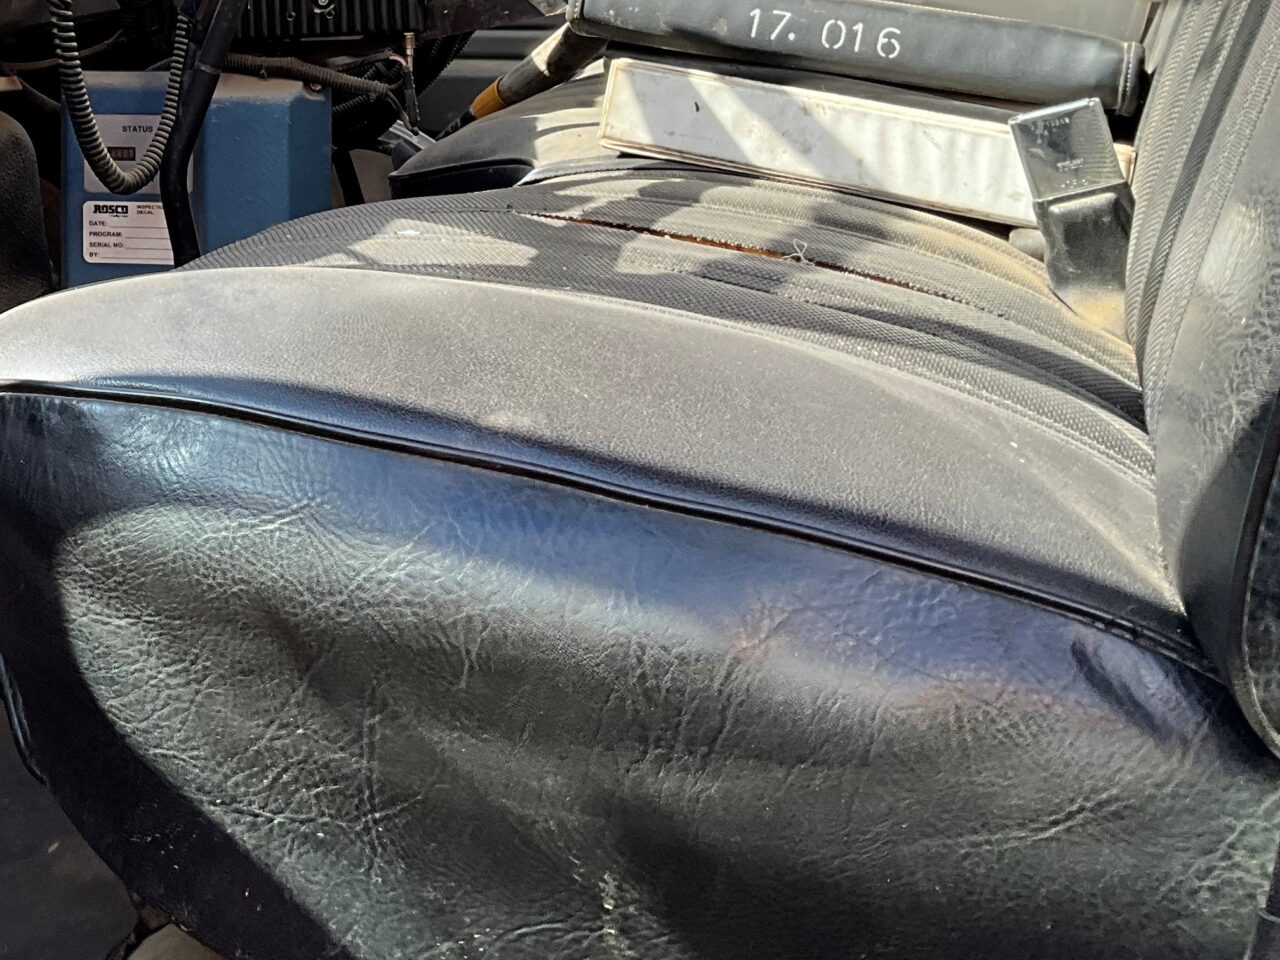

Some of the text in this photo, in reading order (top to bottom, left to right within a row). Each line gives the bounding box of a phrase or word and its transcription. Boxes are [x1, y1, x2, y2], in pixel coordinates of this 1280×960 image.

[749, 8, 902, 59] 17. 016
[93, 204, 128, 214] ROSCO
